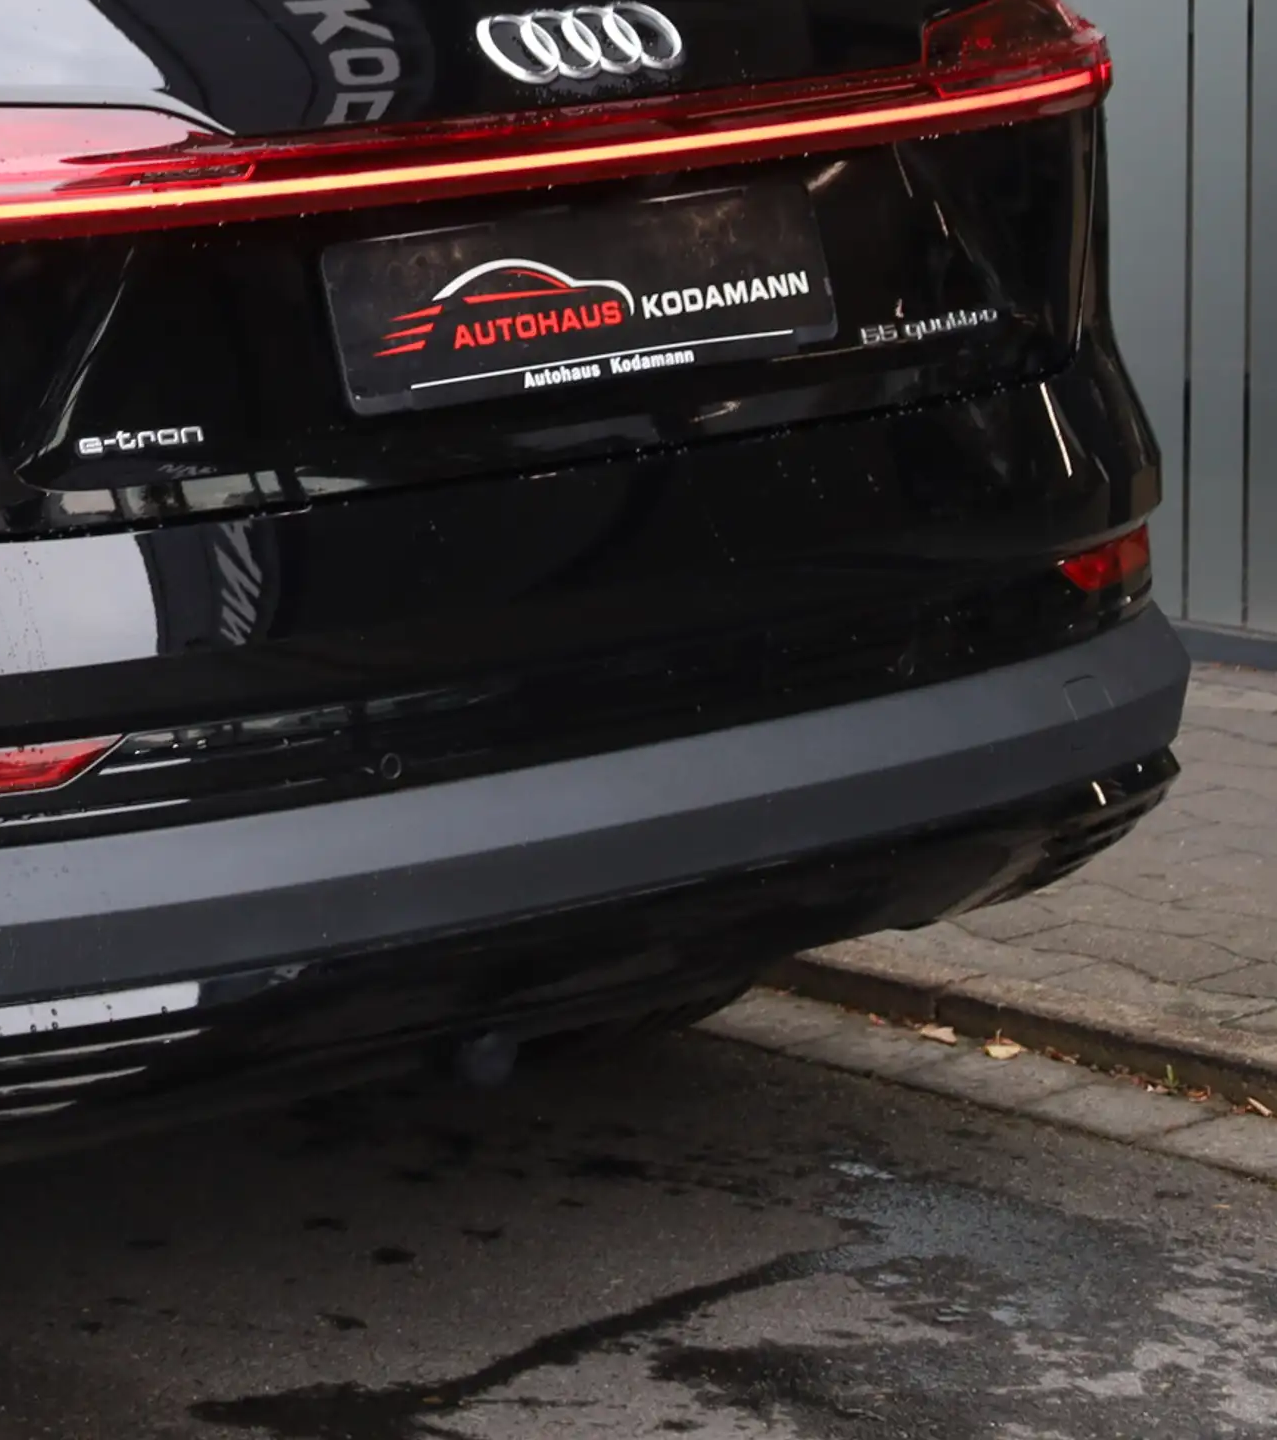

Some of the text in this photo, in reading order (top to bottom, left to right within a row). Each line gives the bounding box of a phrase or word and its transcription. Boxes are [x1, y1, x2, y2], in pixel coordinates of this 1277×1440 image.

[453, 271, 810, 350] AUTOHAUS KODAMANN
[524, 348, 695, 389] Autohaus Kodamann
[78, 426, 204, 455] e-tron
